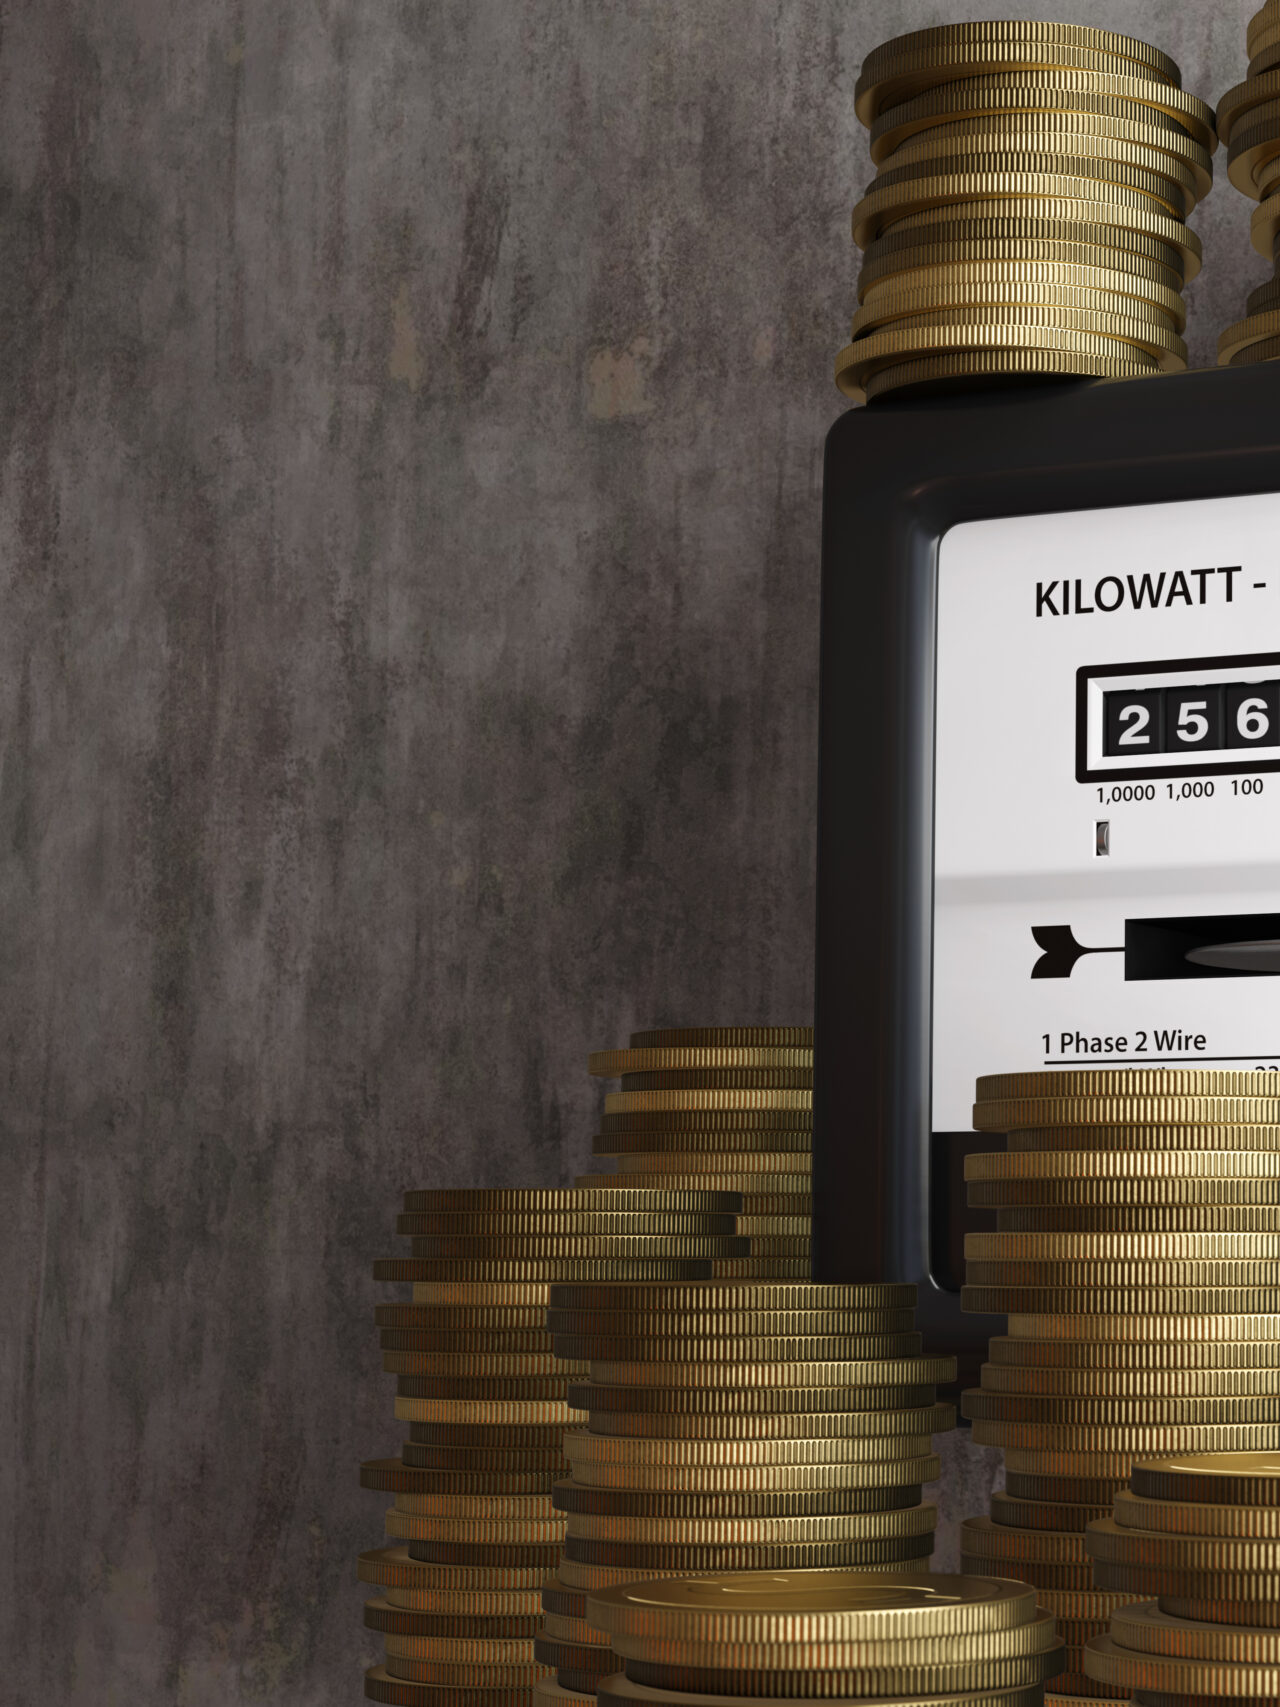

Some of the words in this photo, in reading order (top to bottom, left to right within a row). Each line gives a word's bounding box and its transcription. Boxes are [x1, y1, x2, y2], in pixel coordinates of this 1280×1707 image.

[1035, 565, 1243, 618] KILOWATT
[1096, 784, 1156, 806] 1,0000
[1166, 781, 1215, 802] 1,000
[1231, 778, 1264, 796] 100
[1041, 1033, 1050, 1055] 1
[1060, 1030, 1128, 1054] Phase
[1134, 1030, 1148, 1052] 2
[1153, 1028, 1207, 1052] Wire
